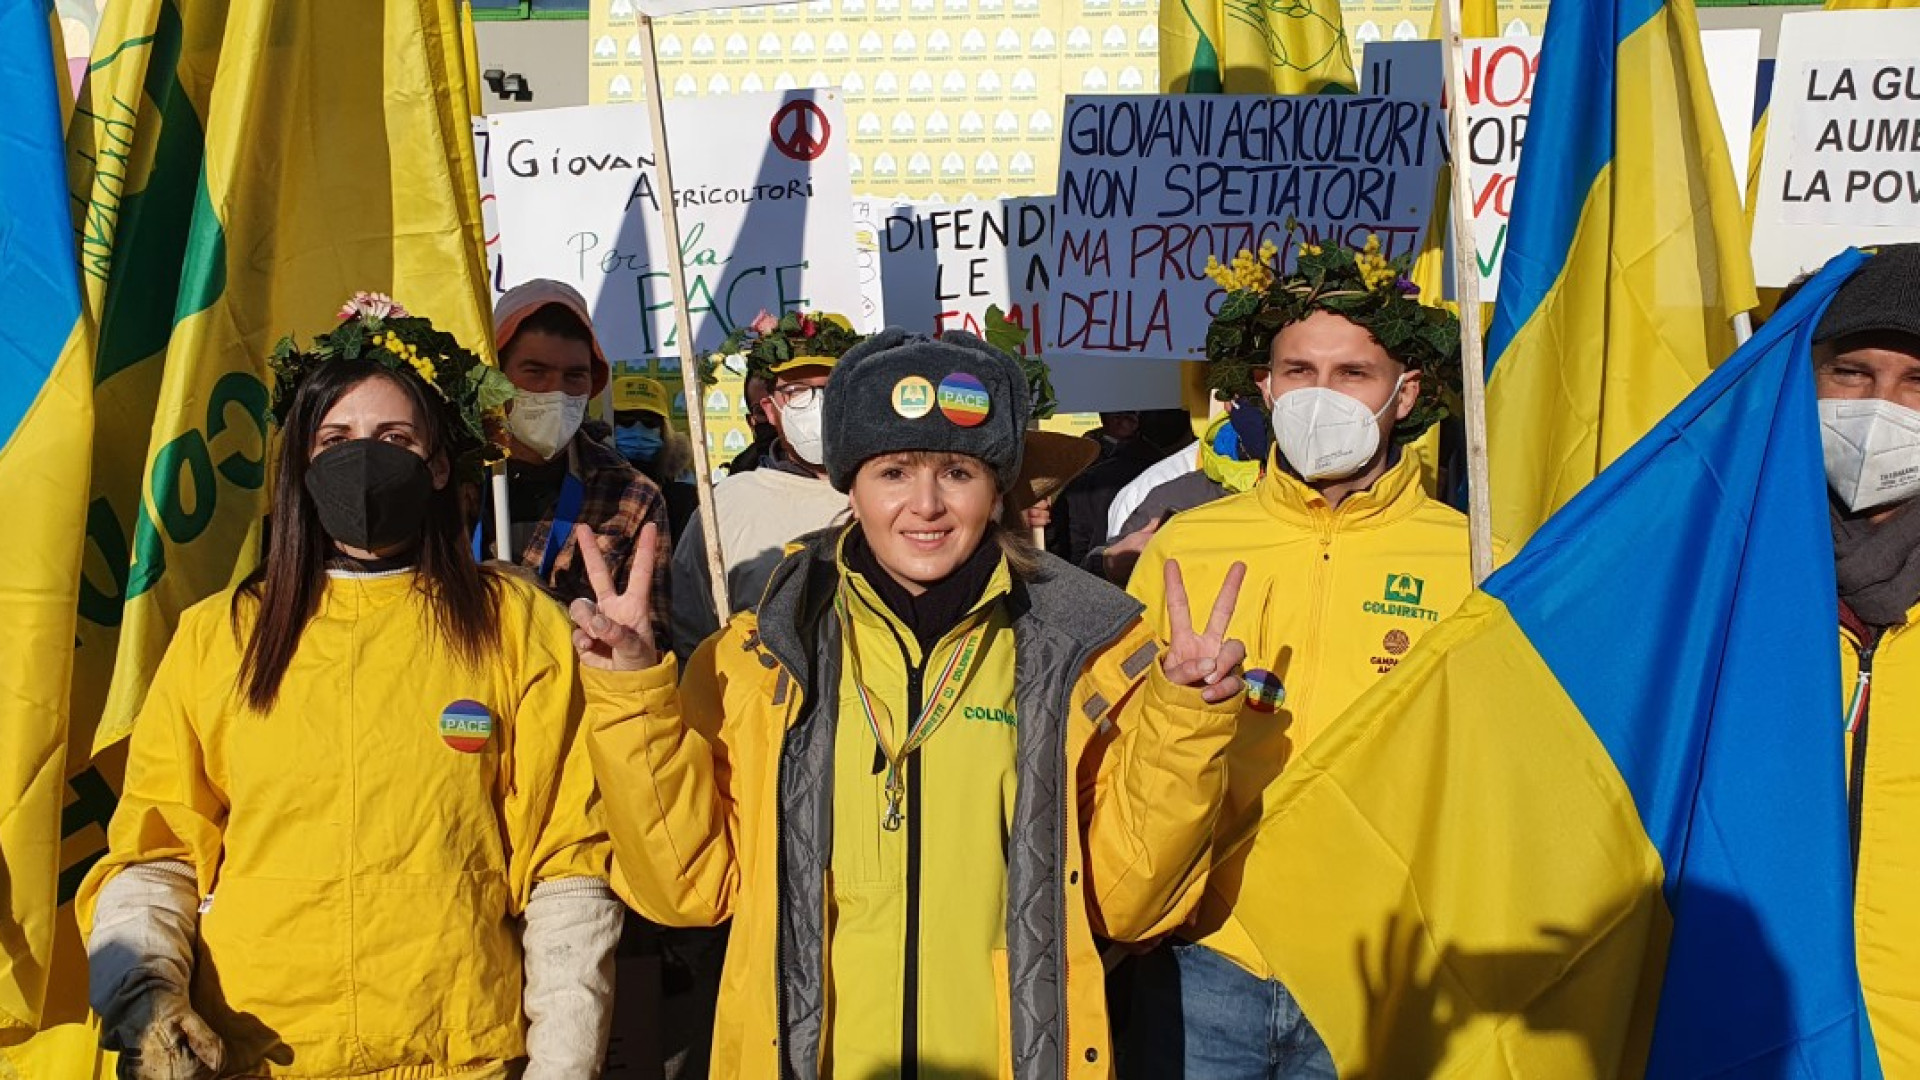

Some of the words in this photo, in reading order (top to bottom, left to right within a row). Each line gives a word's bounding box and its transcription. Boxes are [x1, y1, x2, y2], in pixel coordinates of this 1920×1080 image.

[1807, 69, 1857, 101] LA
[1068, 98, 1214, 158] GIOVANI
[1217, 97, 1430, 167] AGRICOLTORI
[1063, 166, 1137, 218] NON
[1158, 163, 1396, 221] SPETTATORI
[1782, 169, 1831, 202] LA
[567, 231, 649, 282] Per
[1058, 229, 1111, 278] MA
[935, 258, 990, 301] LE
[636, 260, 810, 354] PACE
[1058, 288, 1172, 352] DELLA
[945, 390, 985, 408] PACE
[1362, 600, 1439, 622] COLDIRETTI
[445, 717, 488, 733] PACE
